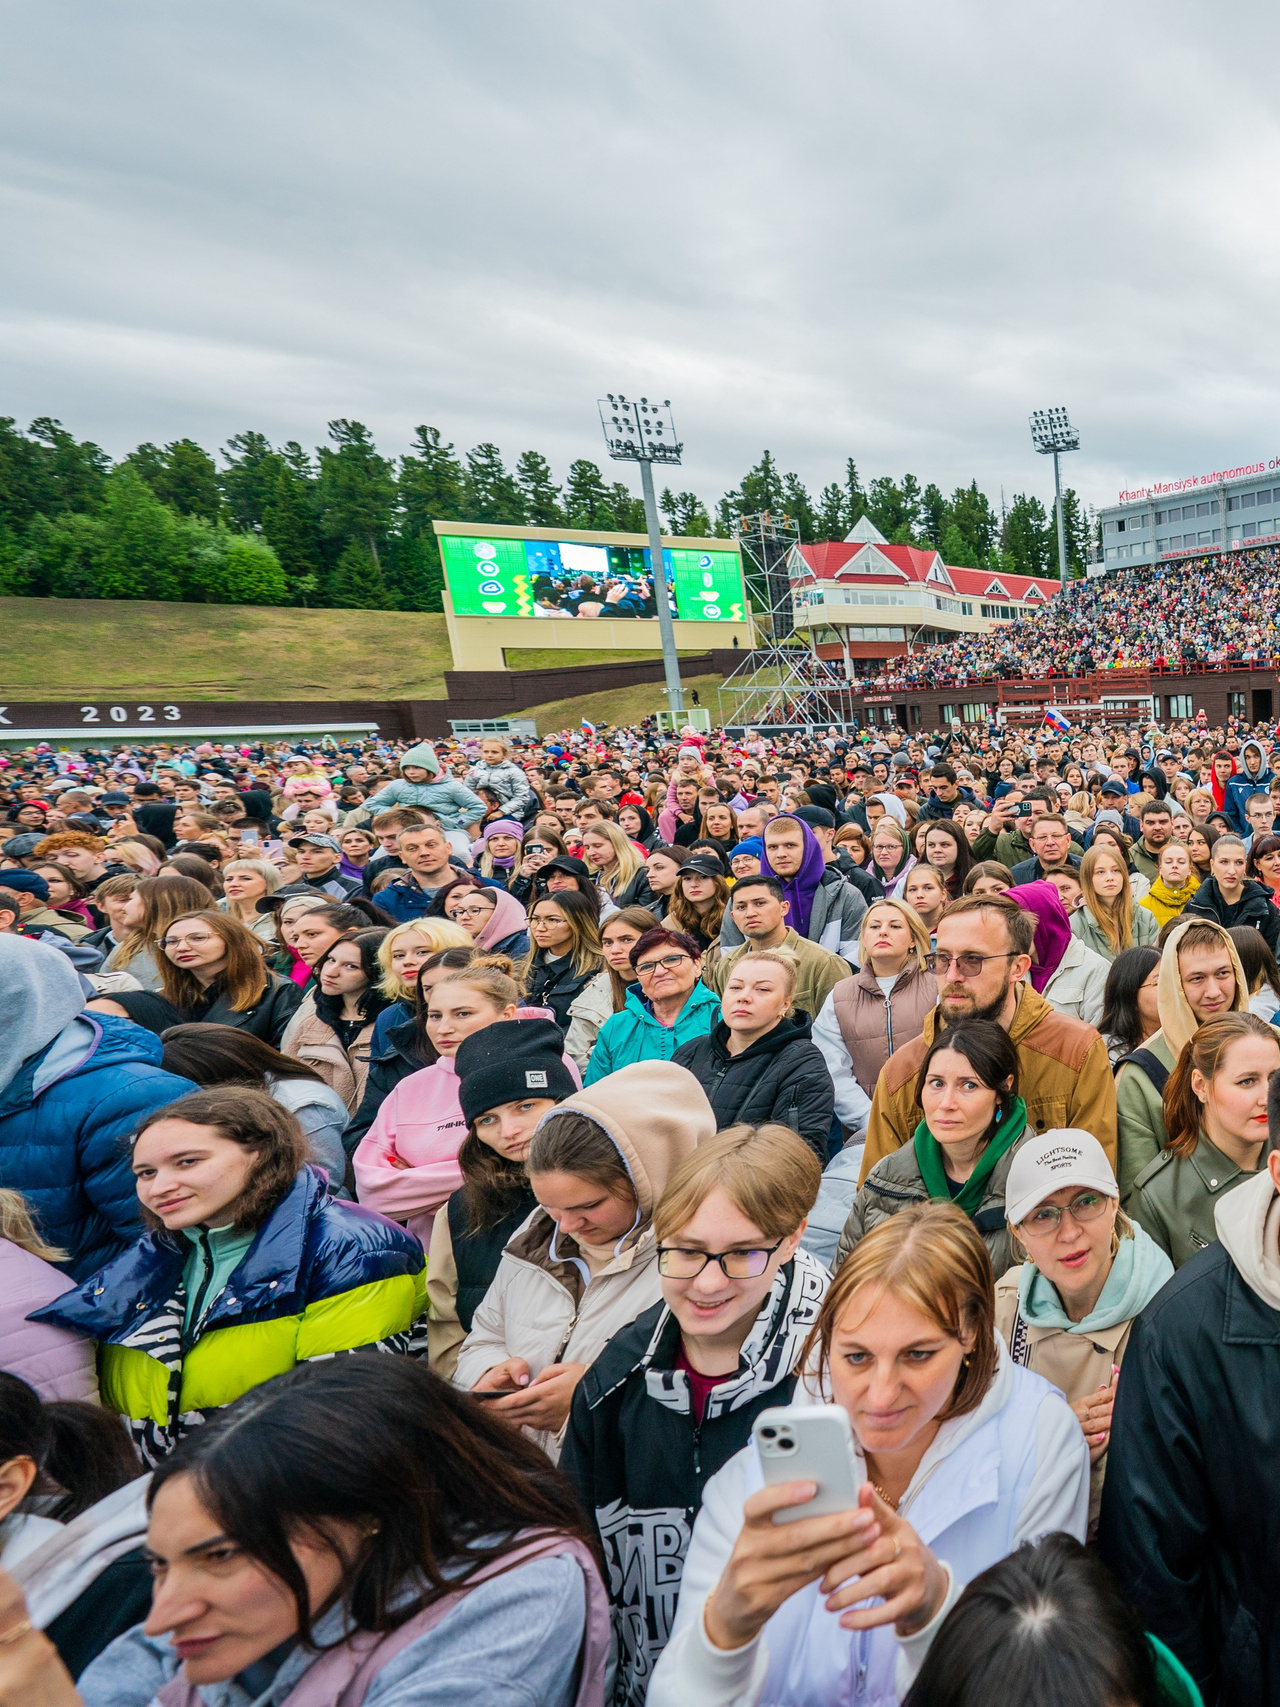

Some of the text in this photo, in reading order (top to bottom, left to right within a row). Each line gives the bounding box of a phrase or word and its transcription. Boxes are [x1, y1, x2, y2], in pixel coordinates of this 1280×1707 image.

[1118, 475, 1198, 502] Khanty-Mansiysk
[1200, 462, 1266, 486] autonomous
[79, 705, 182, 722] 2023
[530, 1074, 544, 1082] ONE
[1036, 1146, 1084, 1166] LIGHTSOME
